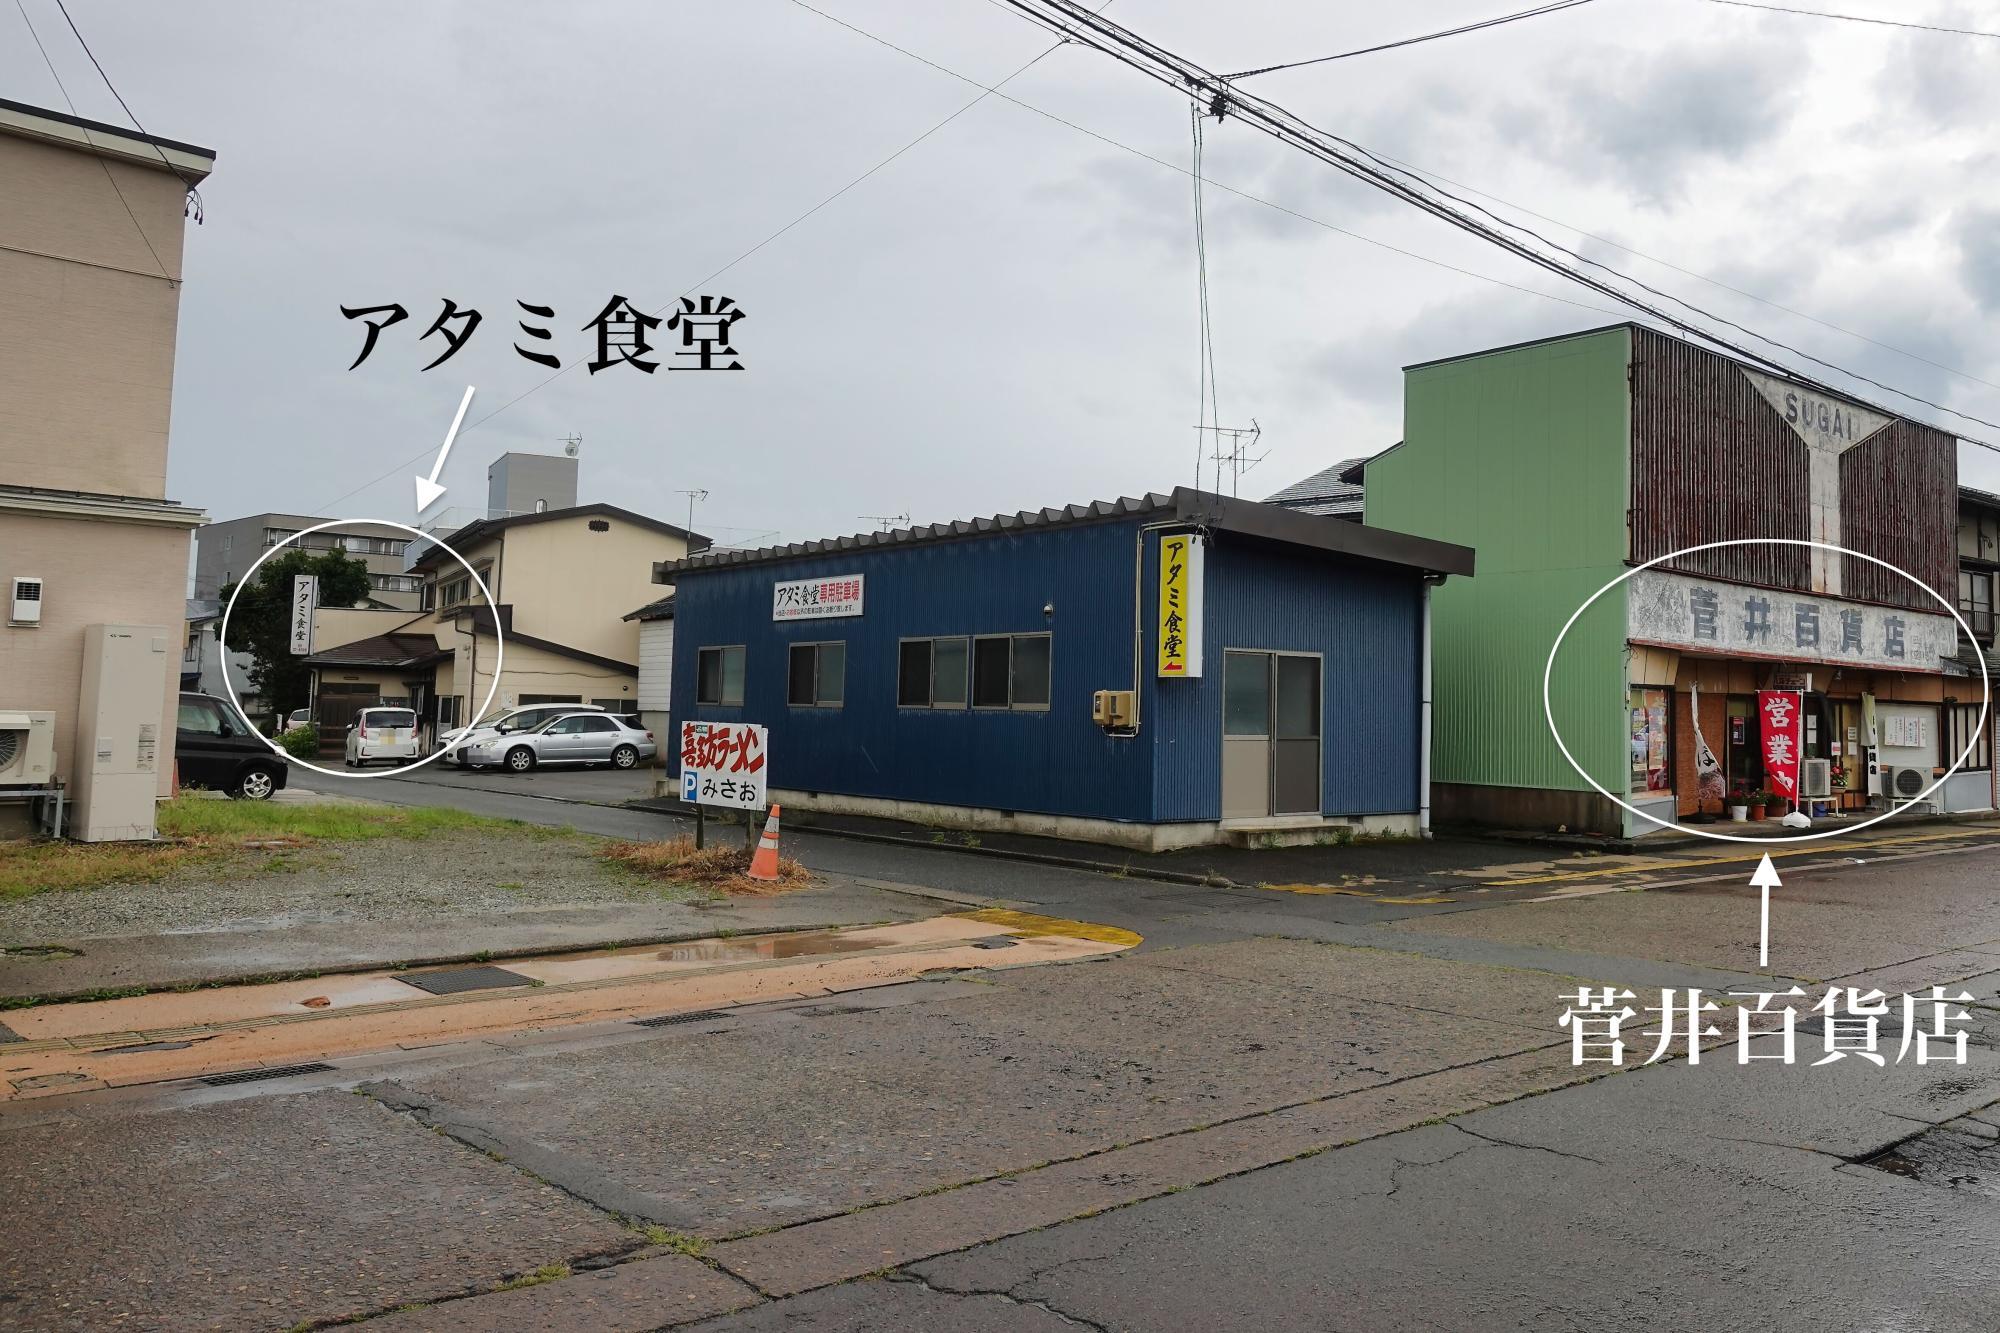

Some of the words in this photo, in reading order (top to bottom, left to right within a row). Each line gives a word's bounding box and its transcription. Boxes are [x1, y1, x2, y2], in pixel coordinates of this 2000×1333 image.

[1785, 392, 1852, 441] SUGAI
[295, 581, 310, 641] アタミ食堂
[1164, 542, 1184, 658] アタミ食堂
[1690, 586, 1906, 659] 菅井百貨店
[681, 722, 765, 774] 喜多方ラーメン
[702, 778, 756, 802] みさお
